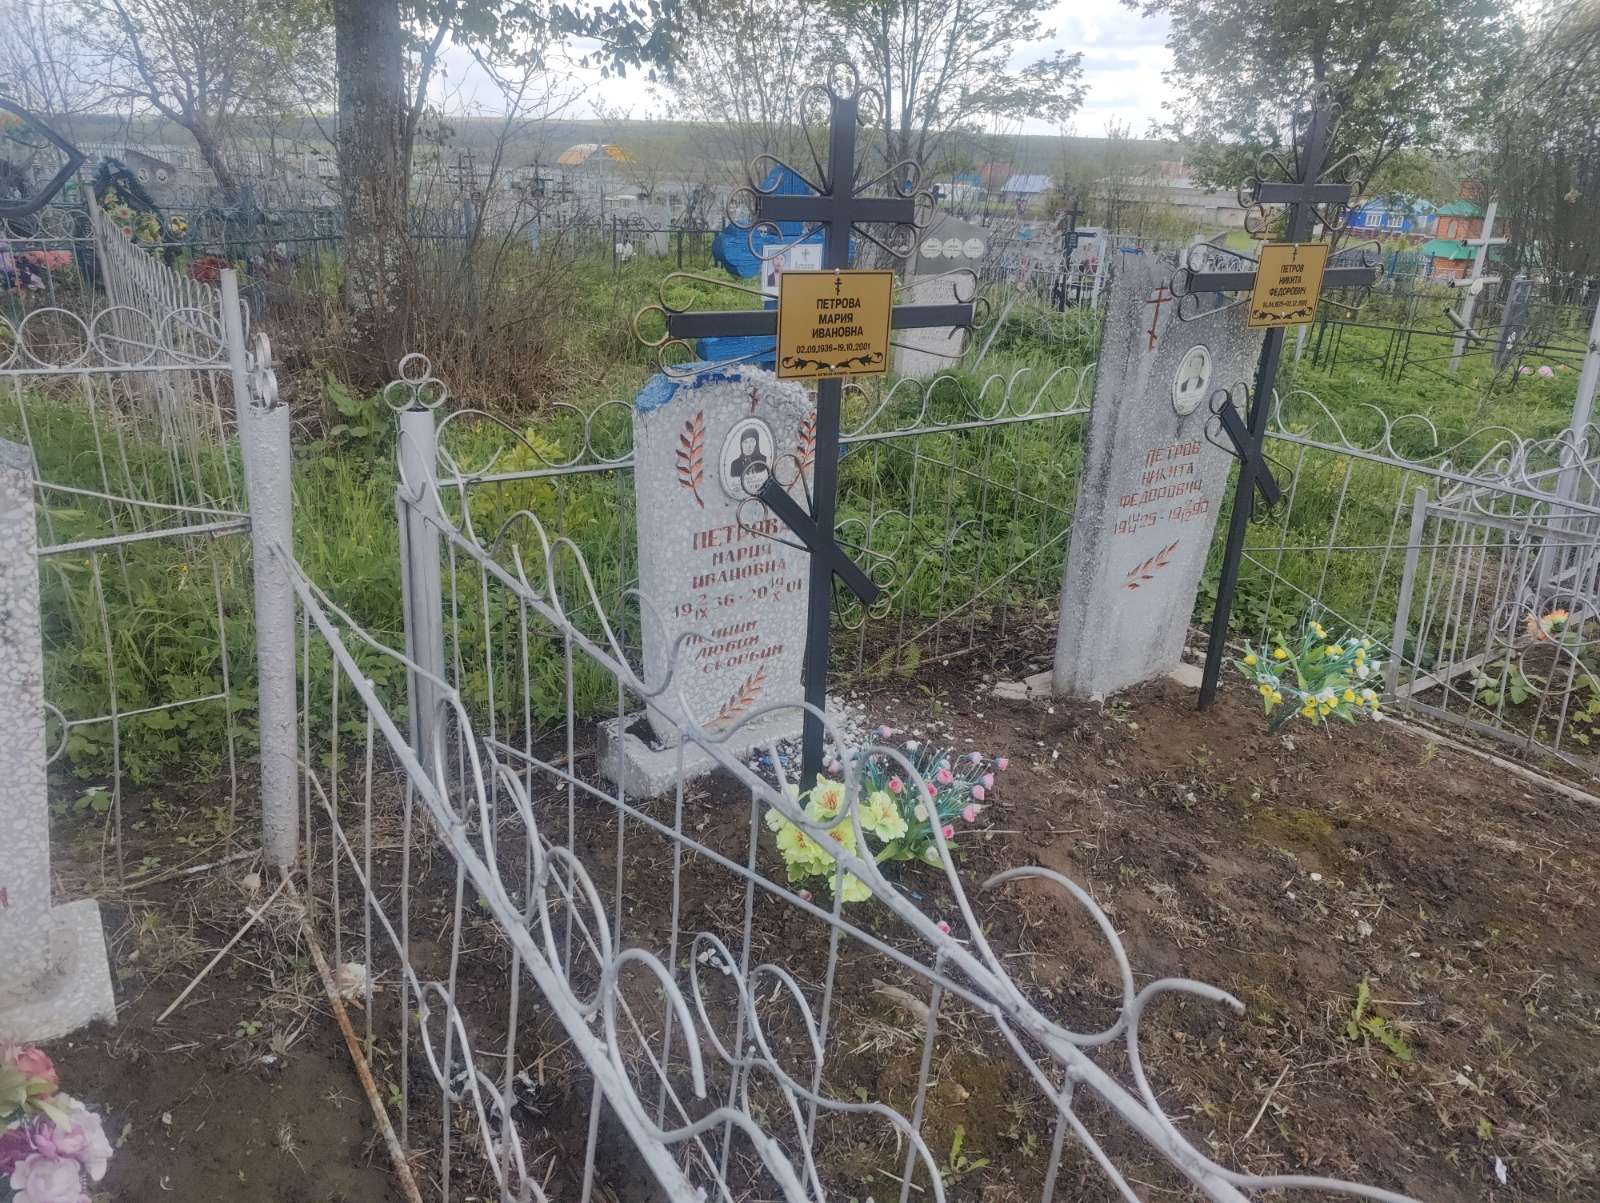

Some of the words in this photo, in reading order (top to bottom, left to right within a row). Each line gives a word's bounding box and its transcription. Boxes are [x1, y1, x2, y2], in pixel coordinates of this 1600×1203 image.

[1280, 264, 1304, 273] ПЕТРОВ
[1279, 276, 1301, 285] НИКИТА
[1269, 287, 1306, 297] ФЕДОРОВИЧ
[816, 298, 861, 310] ПЕТРОВА
[818, 313, 854, 325] МАРИЯ
[812, 326, 864, 339] ИВАНОВНА
[796, 343, 871, 354] 02.09.1936-19.10.2001
[1145, 441, 1202, 469] ПЕТРОВ
[1141, 462, 1194, 487] НИКИТА
[1120, 479, 1203, 508] ФЕДОРОВИЧ
[712, 543, 772, 566] МАРИЯ
[692, 558, 787, 590] ИВАНОВНА
[695, 635, 760, 661] ЛЮБИМ
[703, 644, 783, 674] СКОРБИМ
